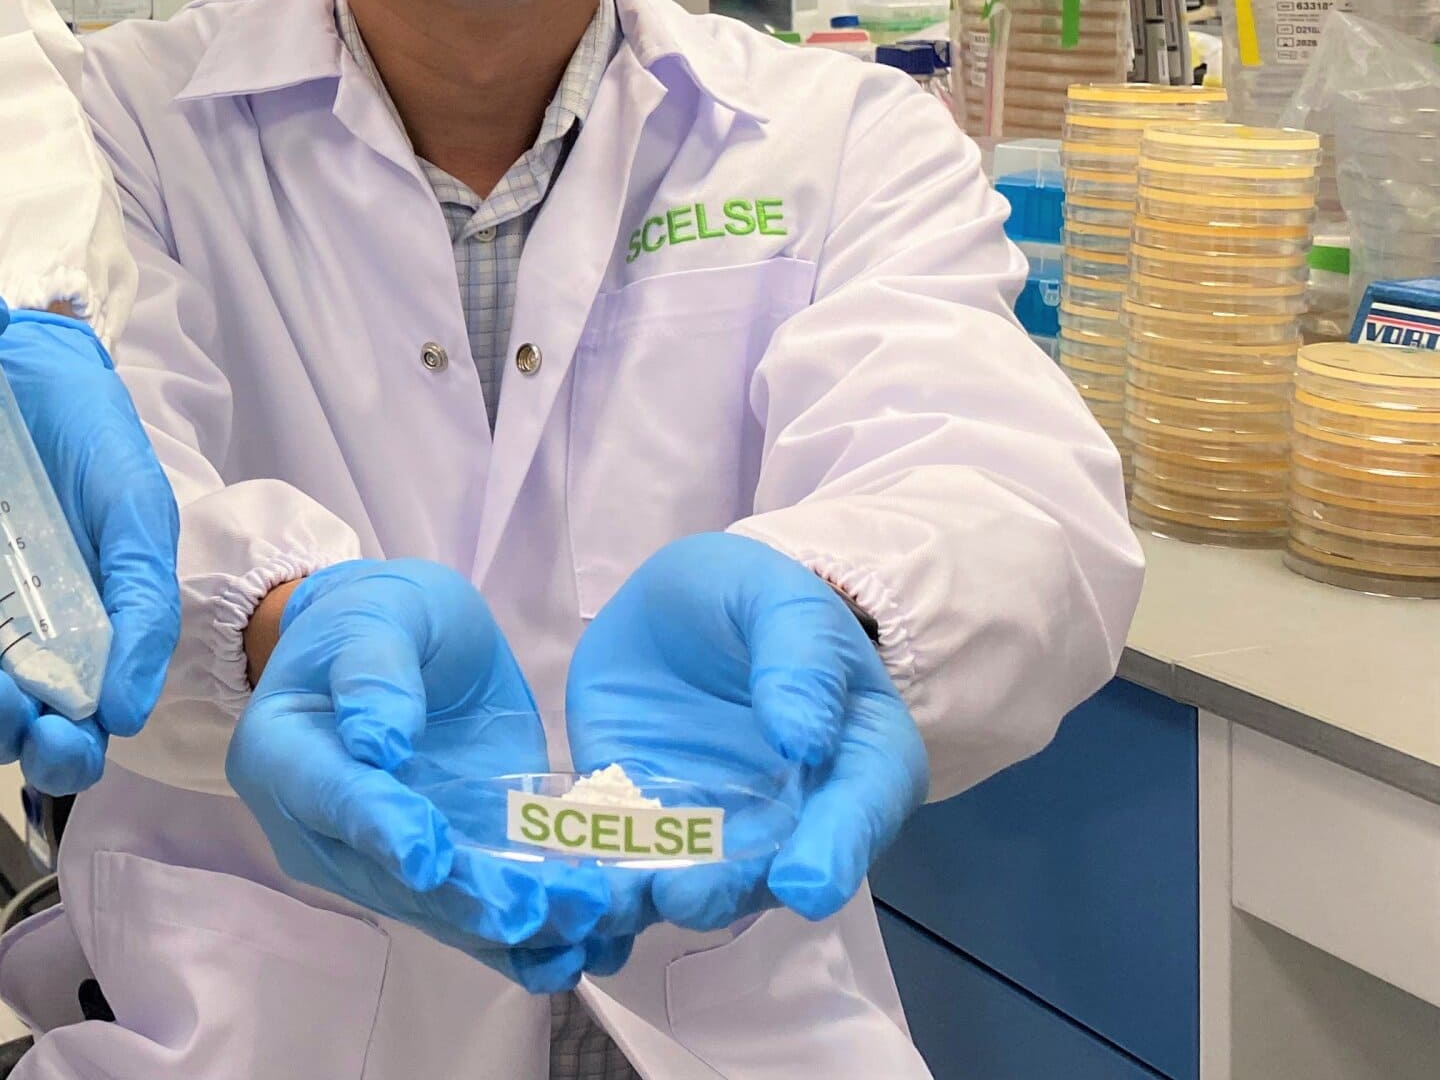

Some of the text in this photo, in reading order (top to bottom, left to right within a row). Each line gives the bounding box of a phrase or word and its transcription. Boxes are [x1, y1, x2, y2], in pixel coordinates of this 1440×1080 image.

[1296, 2, 1334, 11] 63318
[626, 198, 789, 264] SCELSE
[23, 575, 42, 593] 10
[38, 618, 50, 633] 5
[520, 802, 714, 856] SCELSE
